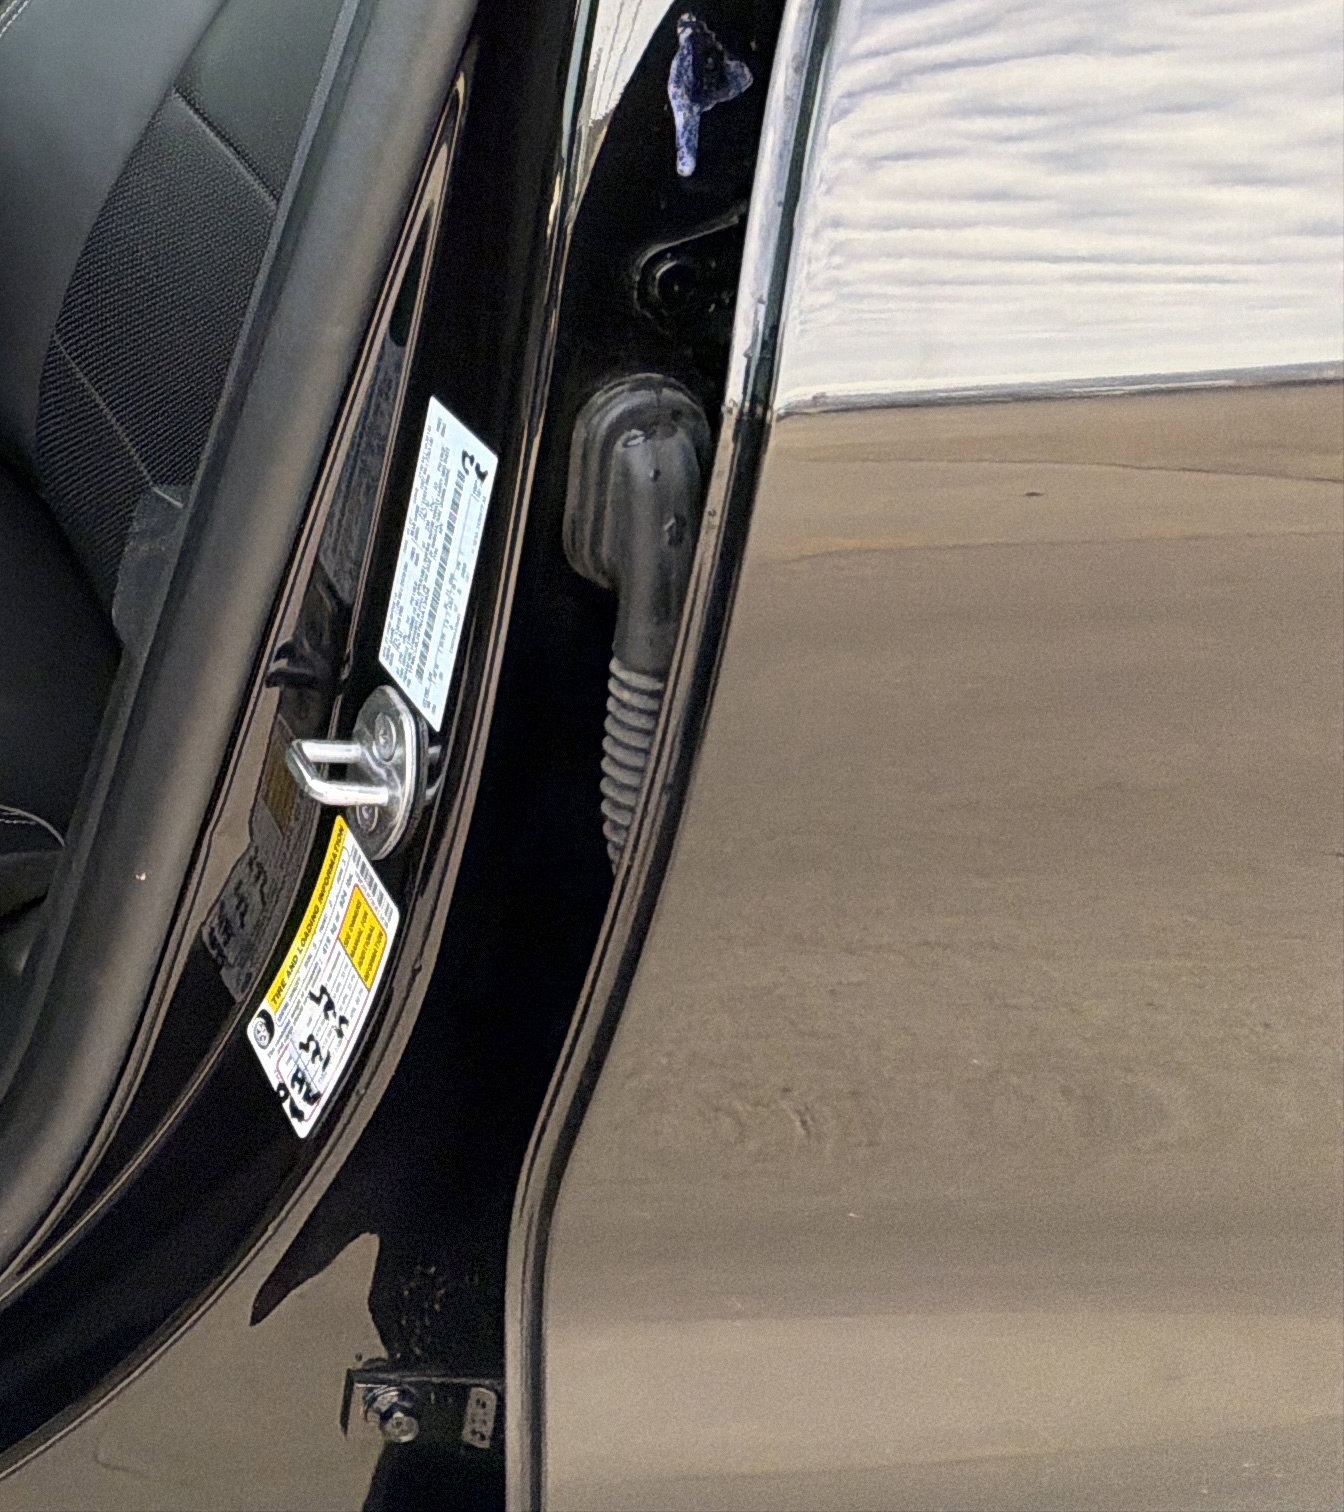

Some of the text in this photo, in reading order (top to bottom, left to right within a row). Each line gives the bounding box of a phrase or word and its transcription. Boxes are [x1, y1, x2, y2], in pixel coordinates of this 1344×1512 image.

[271, 825, 344, 1005] TIRE AND LOADING INFORMATION
